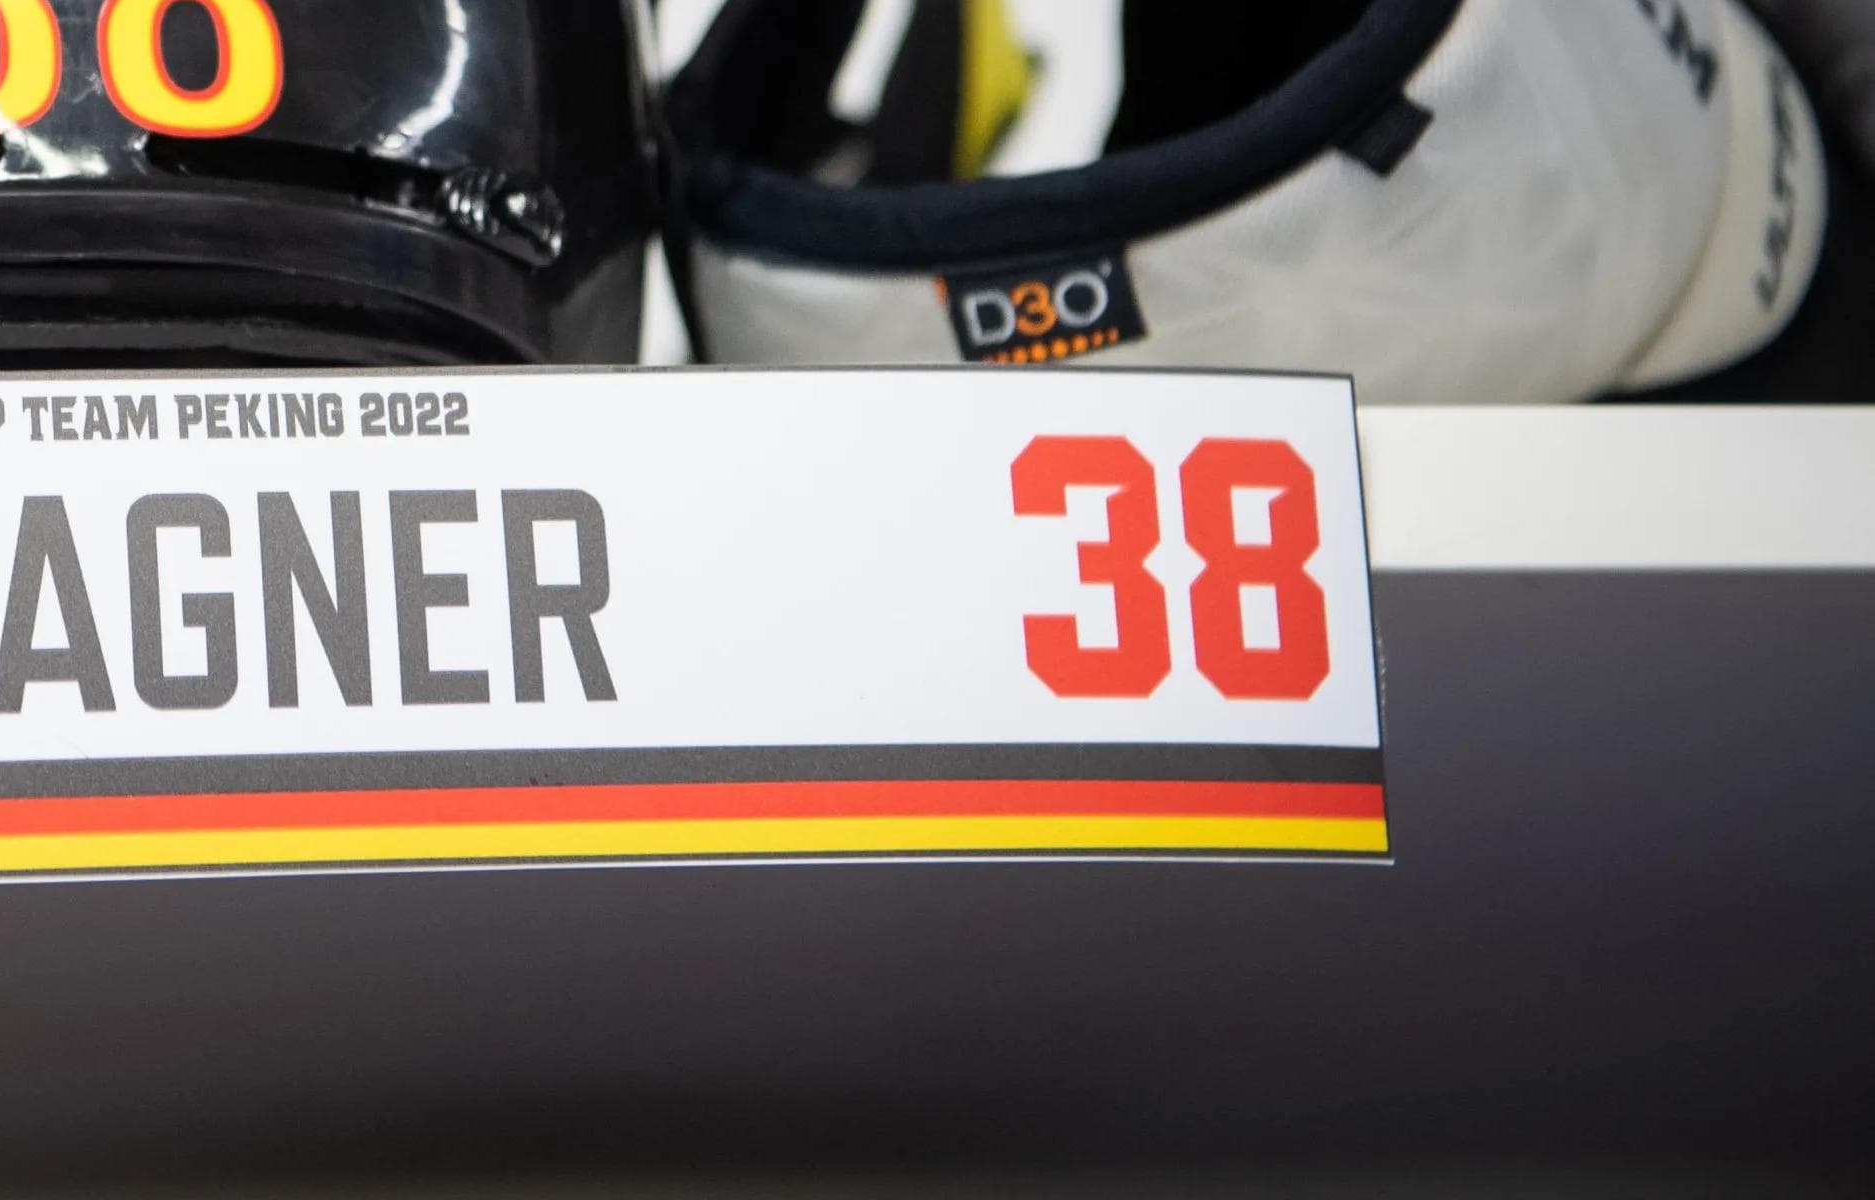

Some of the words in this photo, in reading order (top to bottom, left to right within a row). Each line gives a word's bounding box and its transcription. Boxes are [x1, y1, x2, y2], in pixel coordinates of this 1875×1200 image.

[22, 394, 160, 442] TEAM
[173, 392, 346, 440] PEKING
[359, 391, 472, 438] 2022
[1009, 434, 1331, 702] 38
